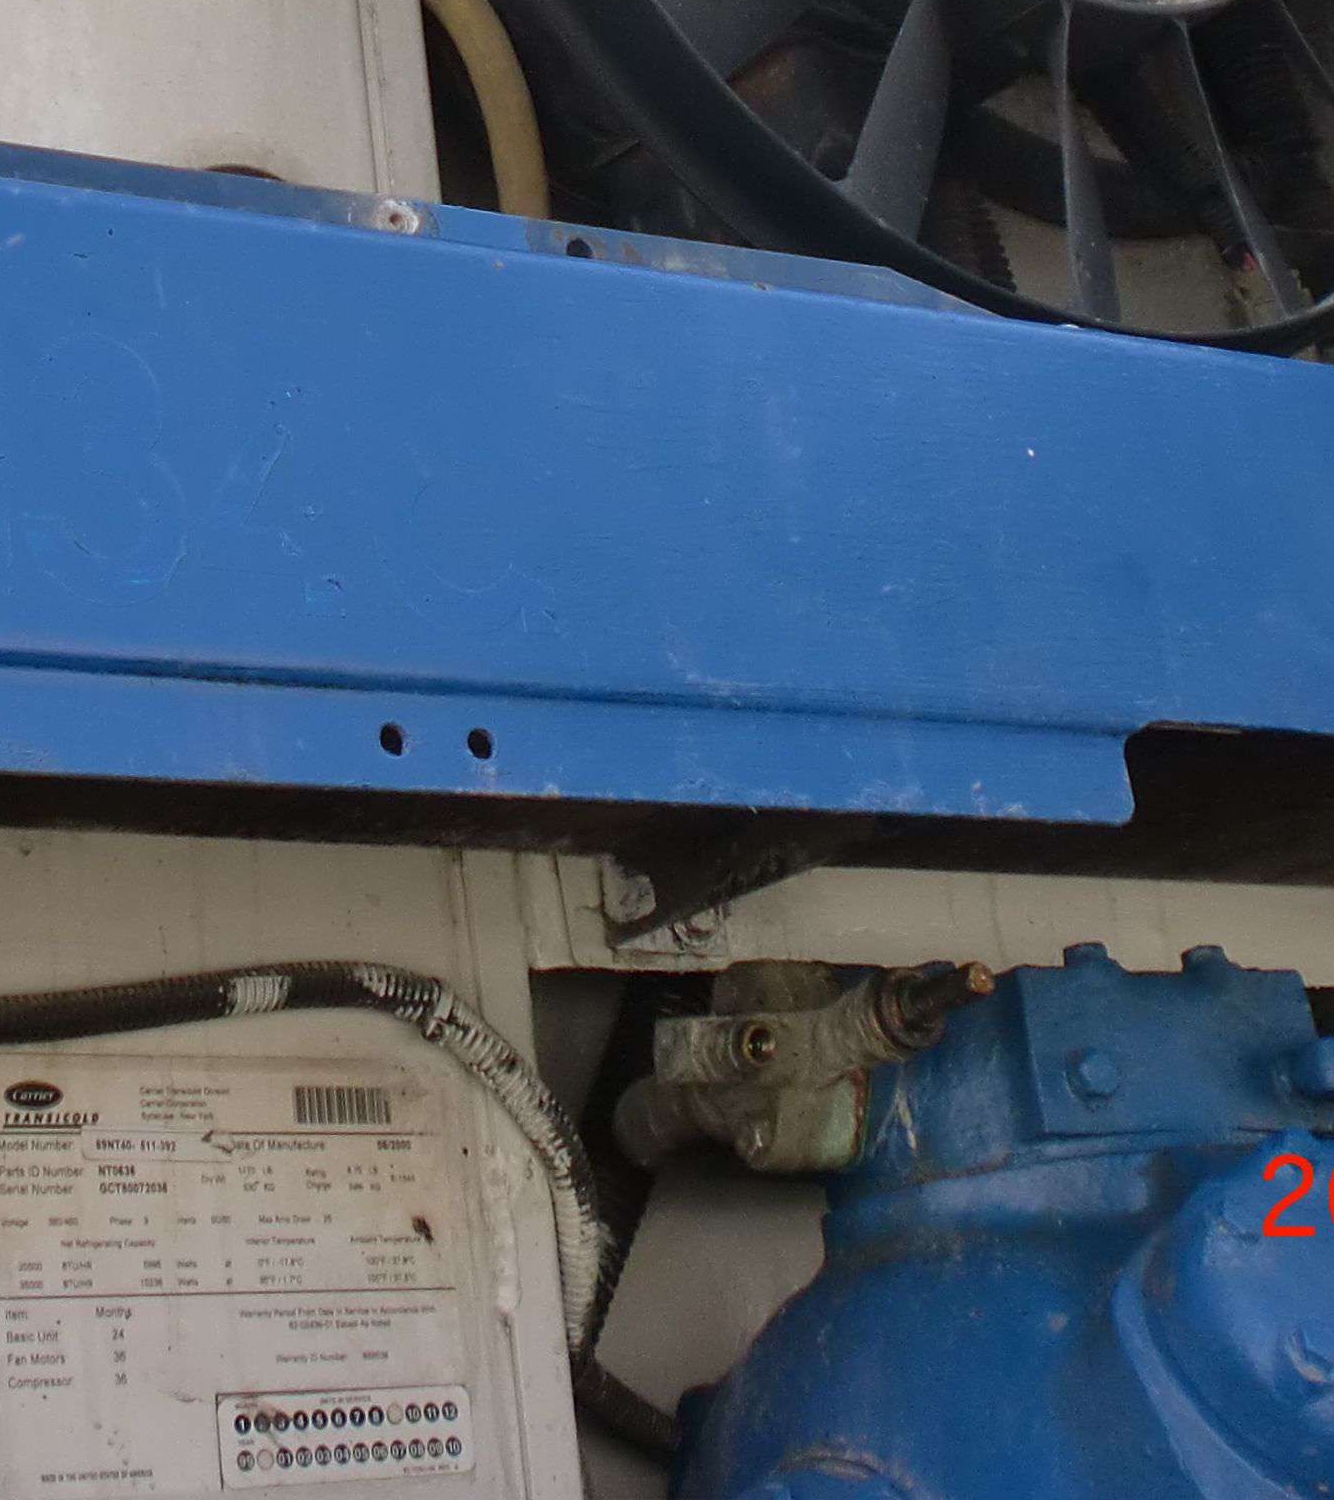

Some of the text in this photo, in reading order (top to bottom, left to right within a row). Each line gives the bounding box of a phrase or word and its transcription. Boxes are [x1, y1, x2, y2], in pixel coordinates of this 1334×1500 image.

[12, 1090, 56, 1101] Carrier
[3, 1112, 100, 1126] TRANSICOLD
[31, 1140, 74, 1150] Number
[267, 1140, 325, 1150] Manufacture
[29, 1166, 41, 1177] ID
[43, 1166, 84, 1177] Number
[0, 1184, 26, 1195] Serial
[32, 1184, 74, 1195] Number
[5, 1308, 28, 1320] Item
[6, 1328, 125, 1343] Basic Unit 24
[7, 1350, 126, 1366] Fan Motors 36
[7, 1372, 128, 1390] Compressor 36
